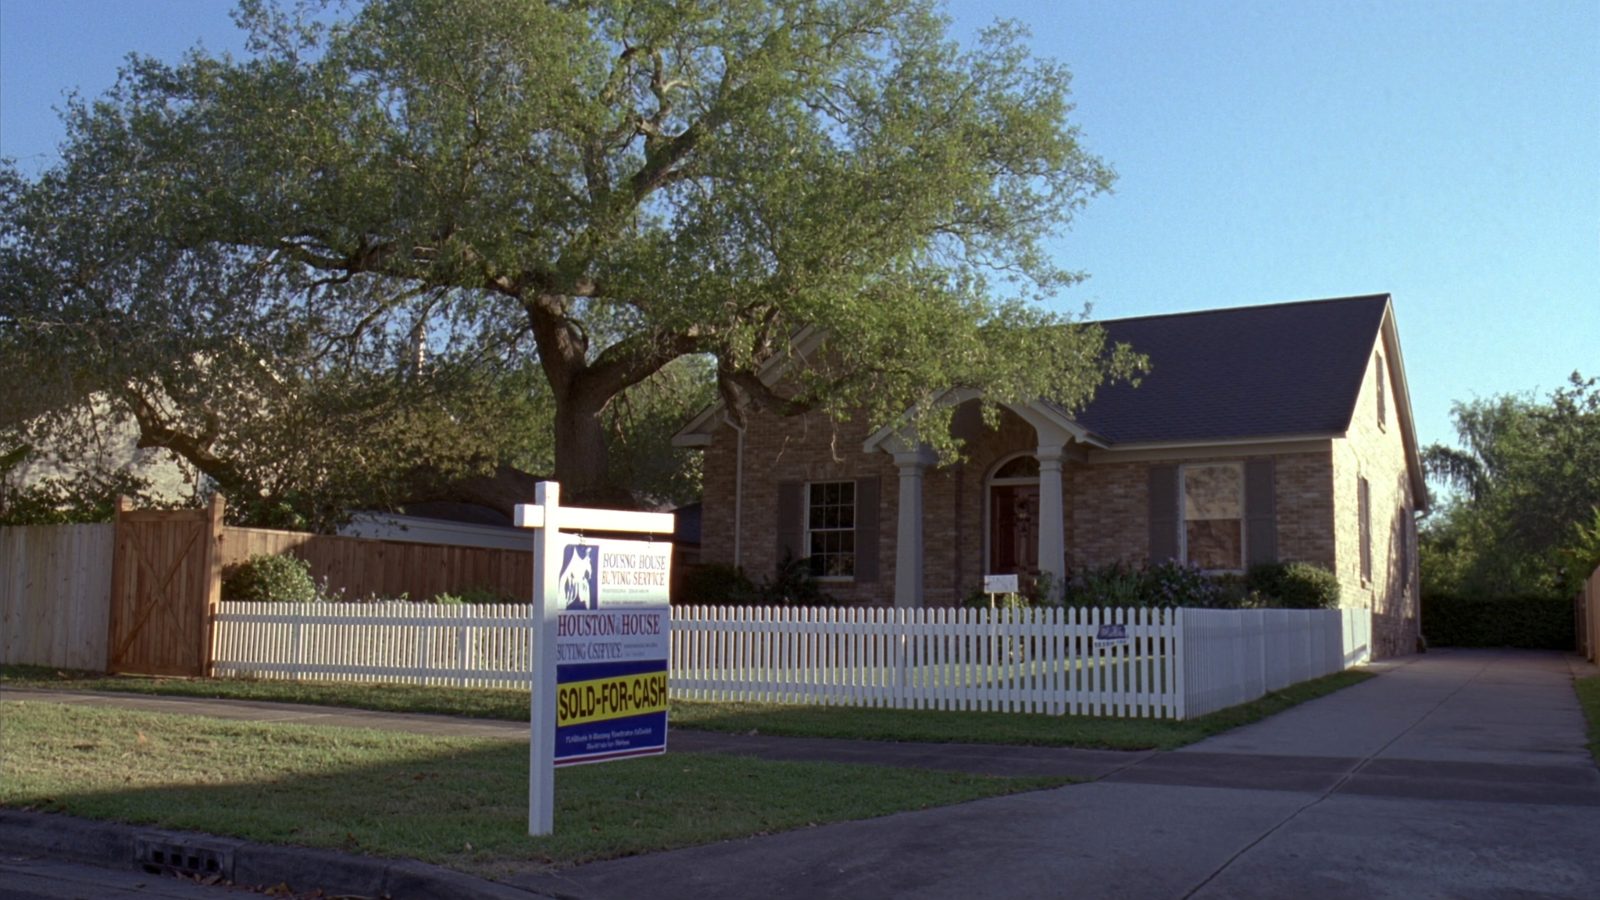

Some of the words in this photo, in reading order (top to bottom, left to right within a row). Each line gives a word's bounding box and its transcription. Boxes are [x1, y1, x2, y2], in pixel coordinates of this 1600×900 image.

[639, 554, 666, 570] HOUSE
[557, 614, 615, 636] HOUSTON
[622, 614, 660, 635] HOUSE
[559, 675, 667, 720] SOLD-FOR-CASH
